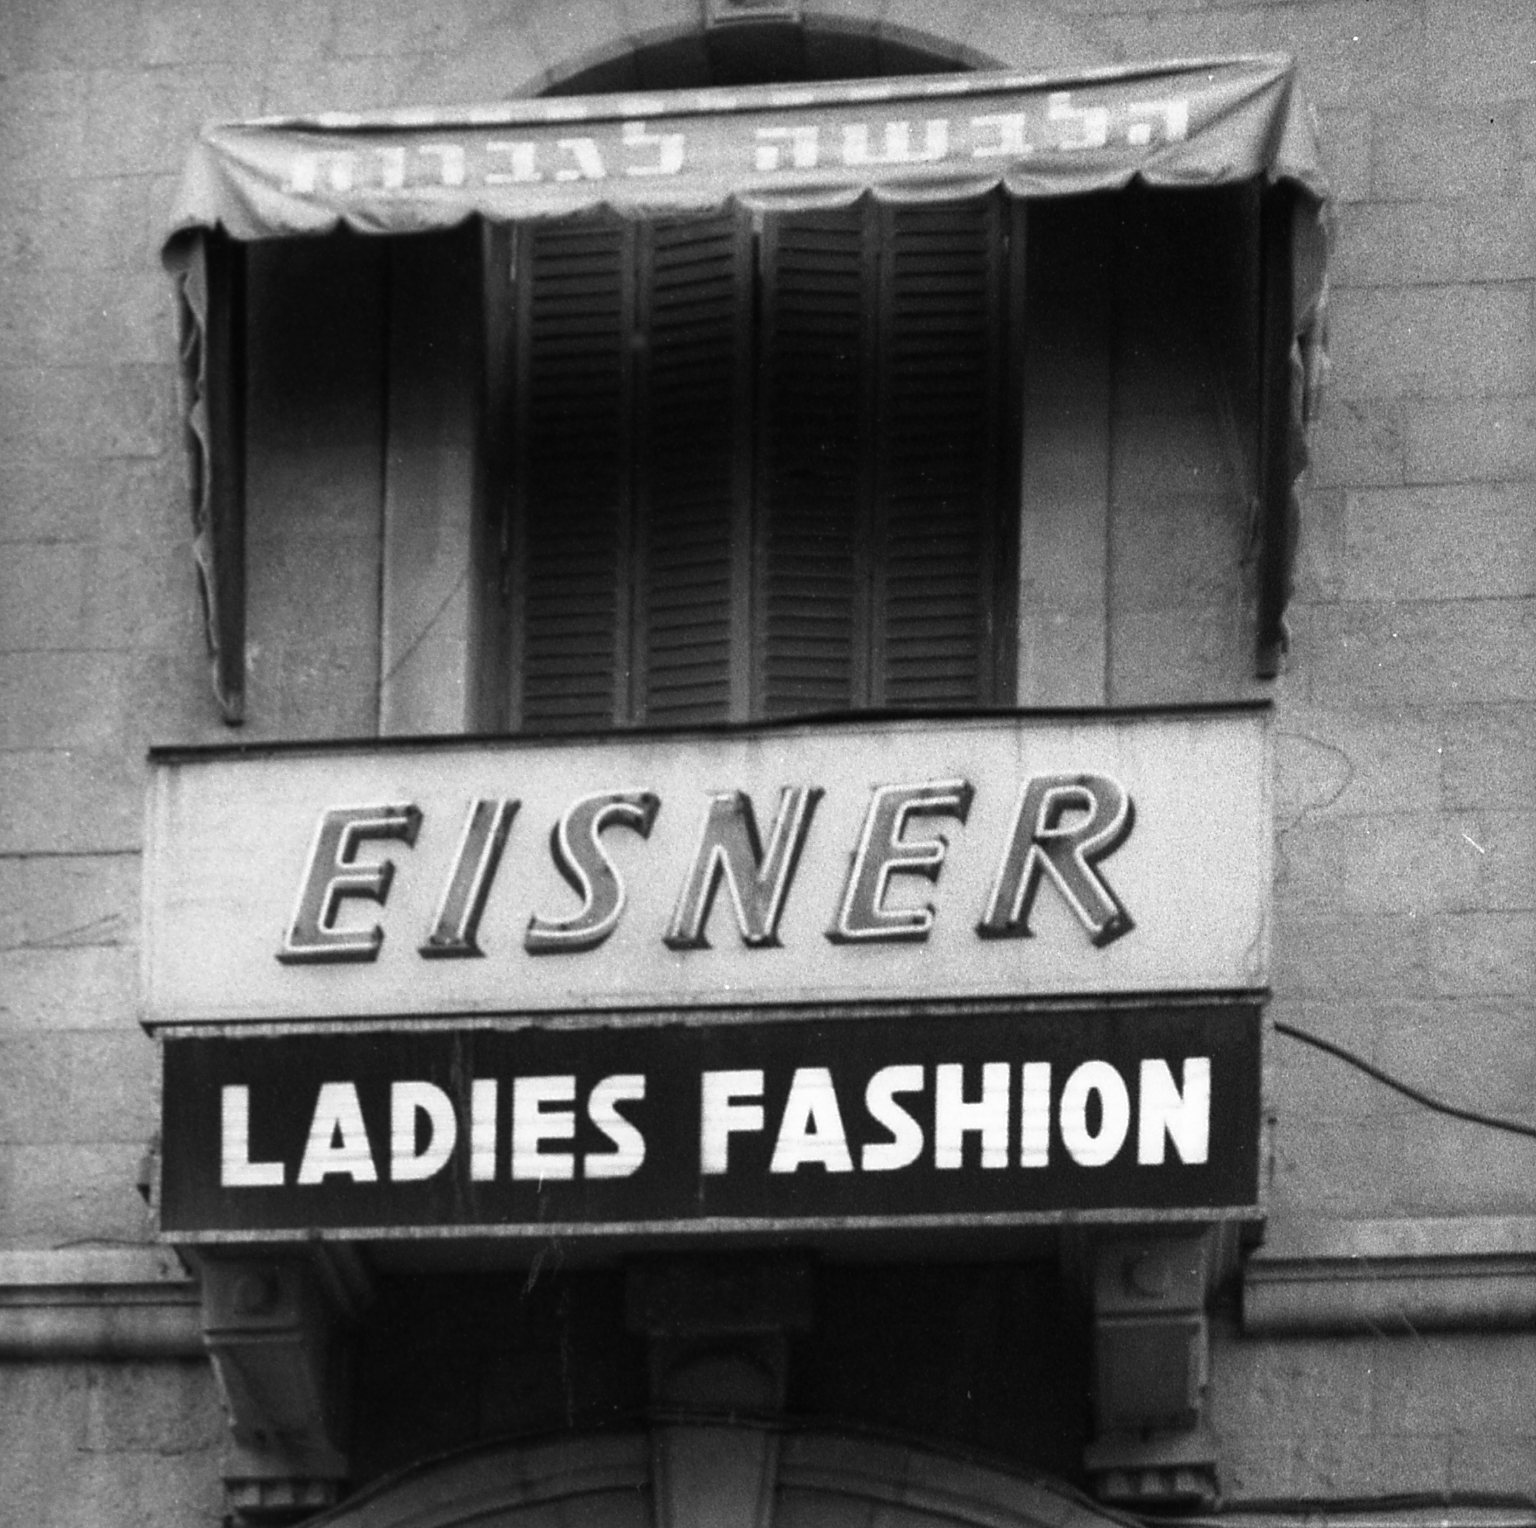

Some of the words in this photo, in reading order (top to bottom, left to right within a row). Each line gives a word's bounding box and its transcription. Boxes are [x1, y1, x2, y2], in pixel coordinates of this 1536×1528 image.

[281, 121, 685, 193] לגברות
[756, 91, 1188, 170] הלבשה
[276, 773, 1135, 963] EISNER
[220, 1075, 647, 1188] LADIES
[700, 1057, 1211, 1177] FASHION
